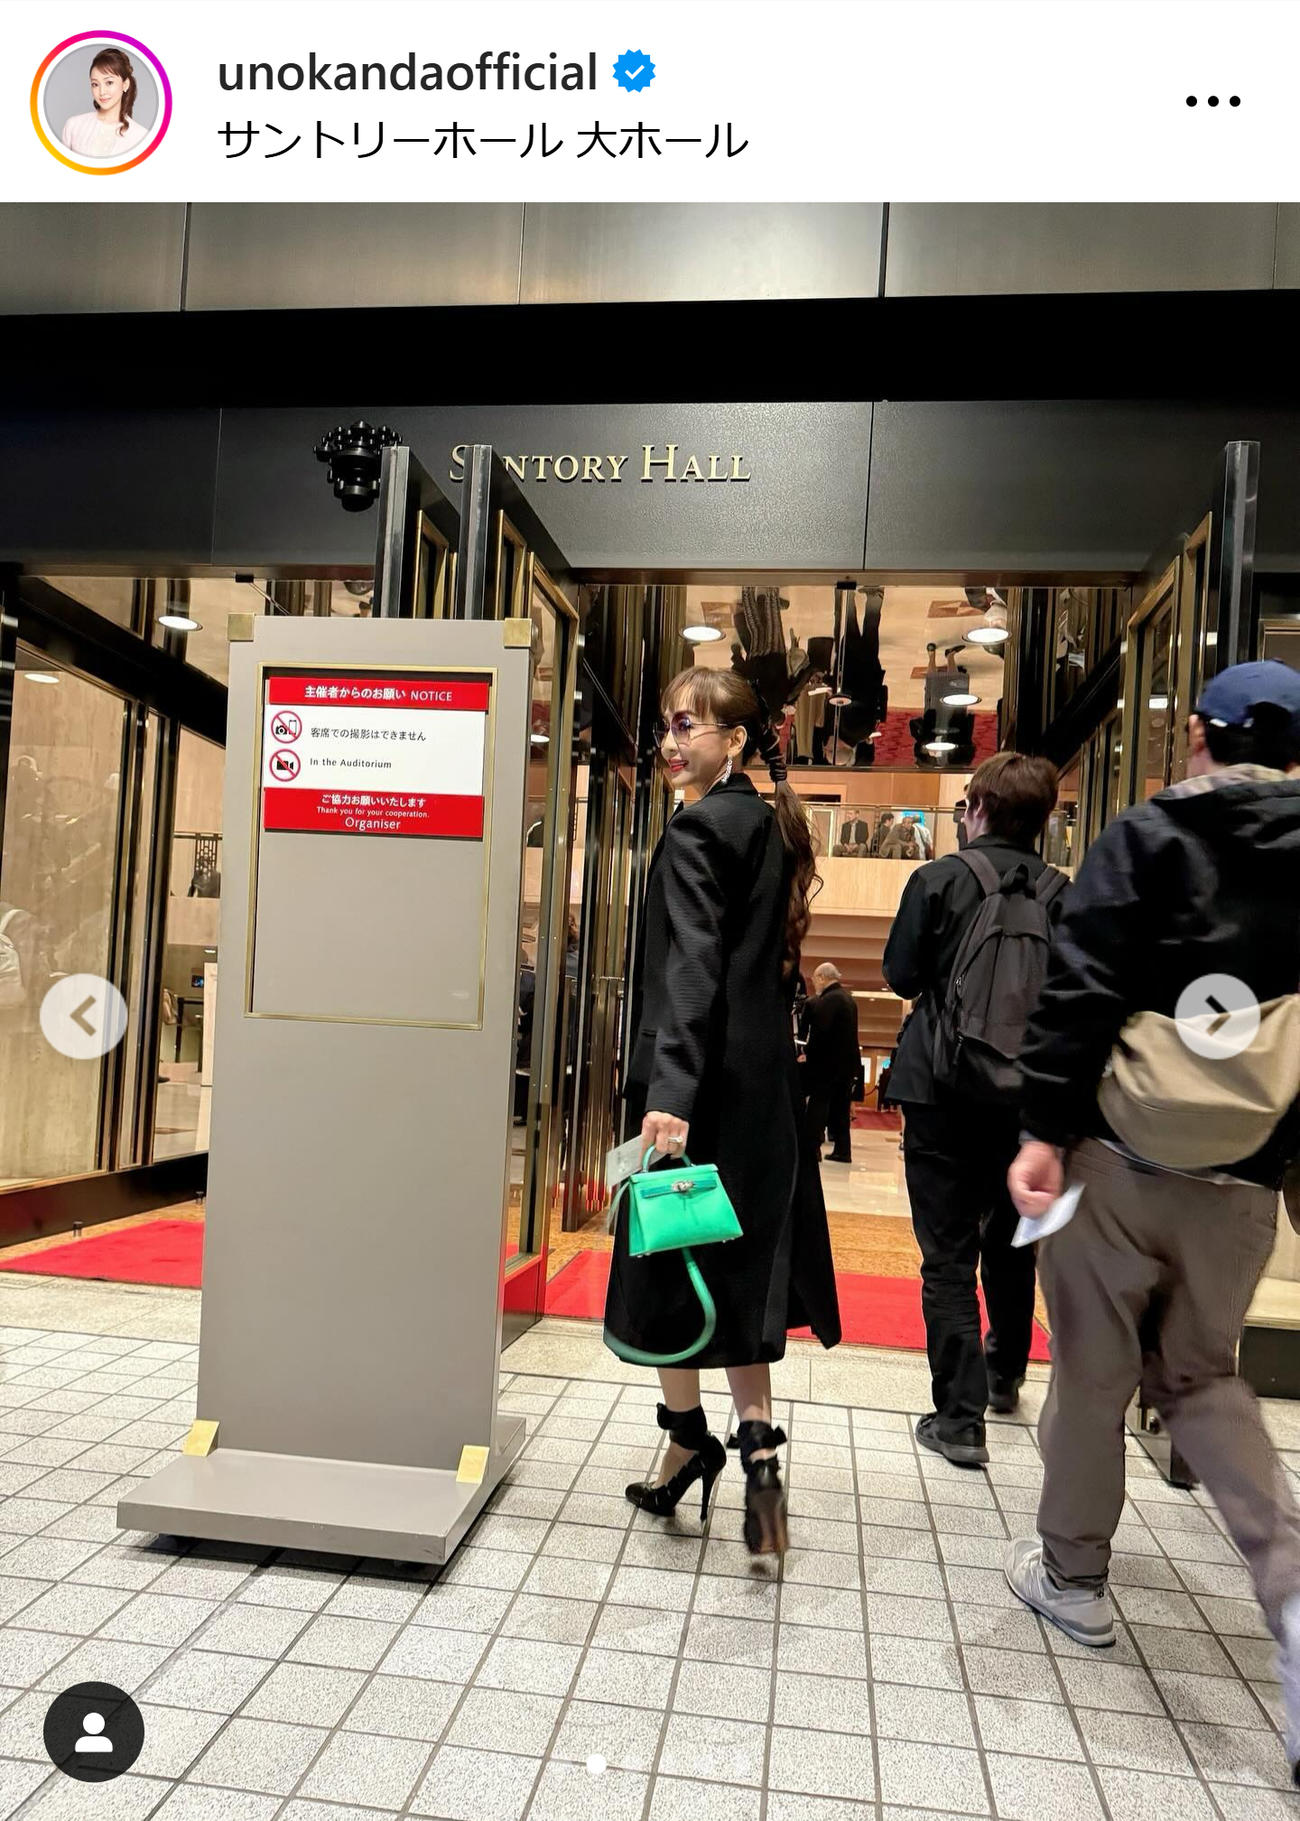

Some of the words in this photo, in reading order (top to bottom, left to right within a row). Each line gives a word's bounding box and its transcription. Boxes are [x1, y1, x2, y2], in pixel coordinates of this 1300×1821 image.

[449, 444, 628, 480] SNTORY
[641, 444, 751, 480] HALL
[305, 686, 406, 700] 主催者からのお願い
[411, 691, 453, 702] NOTICE
[310, 727, 426, 741] 客席での撮影はできません
[310, 758, 319, 766] In
[322, 758, 337, 766] the
[340, 759, 392, 768] Auditorium
[322, 794, 426, 807] ご協力お願いいたします
[317, 806, 339, 815] Thank
[355, 807, 365, 815] for
[385, 810, 430, 819] cooperation.
[345, 817, 401, 830] Organiser
